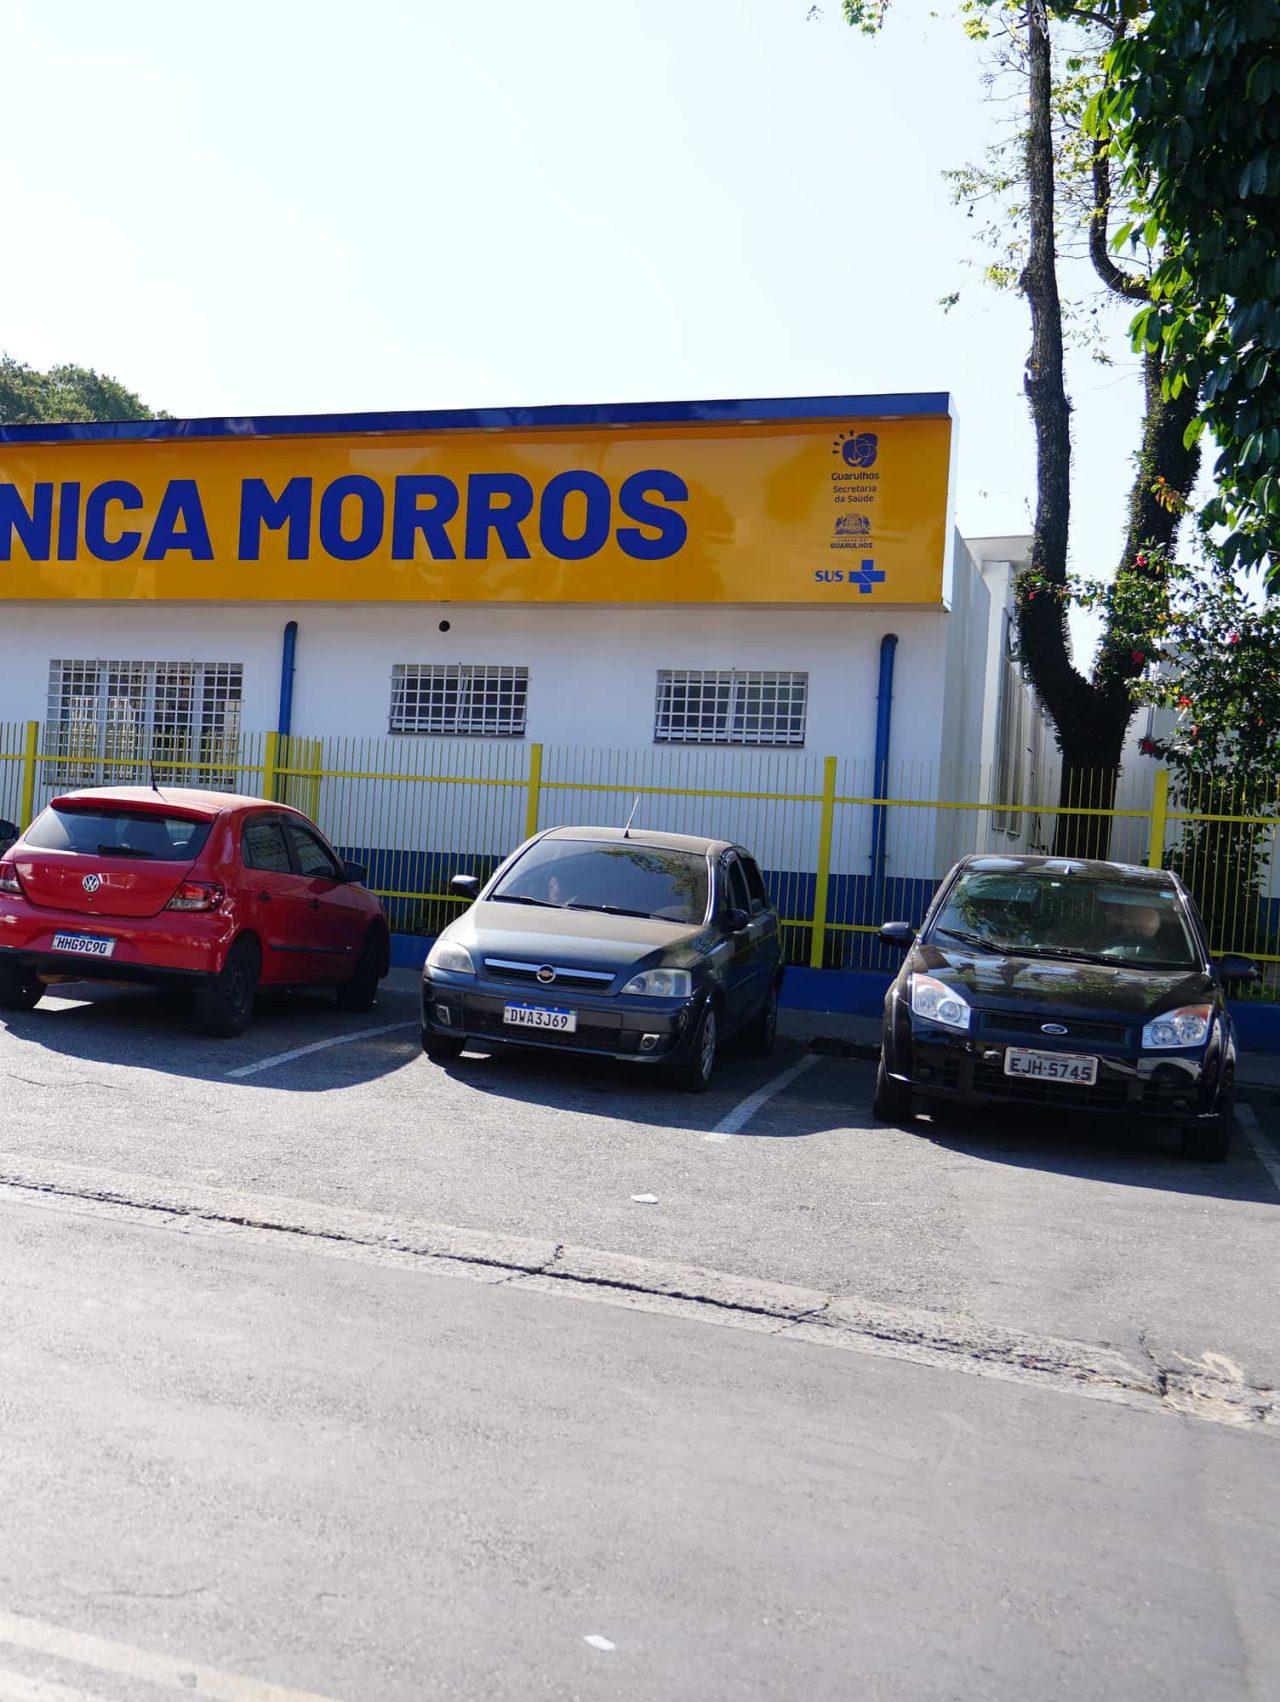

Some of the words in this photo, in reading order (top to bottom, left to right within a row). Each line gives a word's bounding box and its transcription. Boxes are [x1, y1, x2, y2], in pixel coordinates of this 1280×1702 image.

[831, 472, 880, 481] Guarulhos
[832, 485, 877, 493] Secretaria
[834, 495, 845, 503] da
[847, 495, 874, 503] Saúde
[238, 469, 688, 560] MORROS
[815, 570, 844, 582] SUS
[56, 937, 108, 954] HHG9C90
[510, 1008, 568, 1029] DWA3J69
